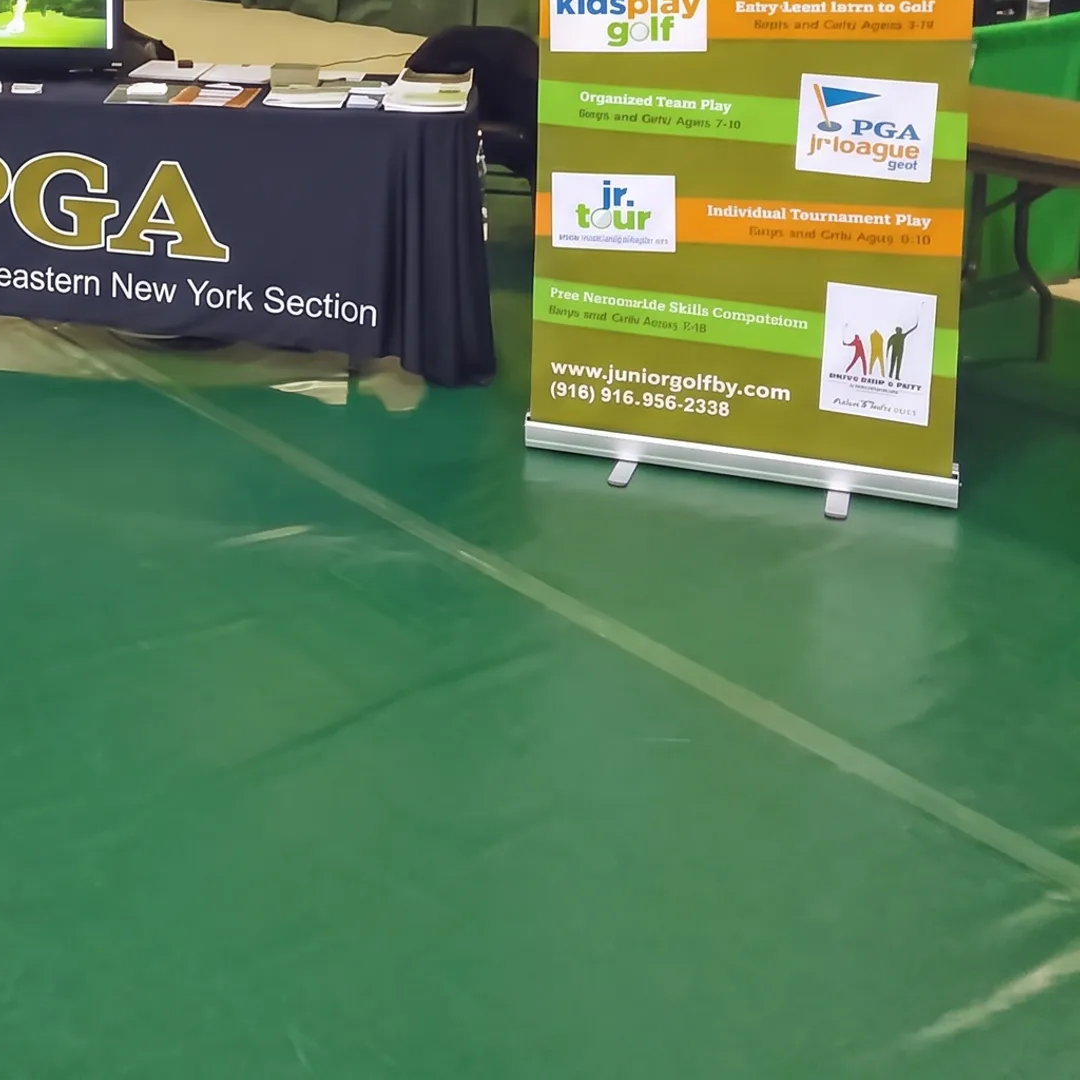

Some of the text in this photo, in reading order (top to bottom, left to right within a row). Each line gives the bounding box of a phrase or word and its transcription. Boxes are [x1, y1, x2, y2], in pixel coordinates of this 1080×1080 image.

[878, 1, 895, 13] to
[607, 16, 675, 47] golf
[580, 91, 732, 115] Organized Team Play
[614, 113, 638, 123] and
[851, 119, 921, 141] PGA
[603, 180, 634, 210] jr.
[707, 205, 932, 230] Individual Tournament Play
[111, 271, 177, 303] New
[186, 278, 253, 312] York
[263, 287, 377, 327] Section
[669, 301, 709, 317] Skills
[550, 361, 791, 401] www.juniorgolfby.com
[550, 381, 731, 417] (916) 916.956-2338
